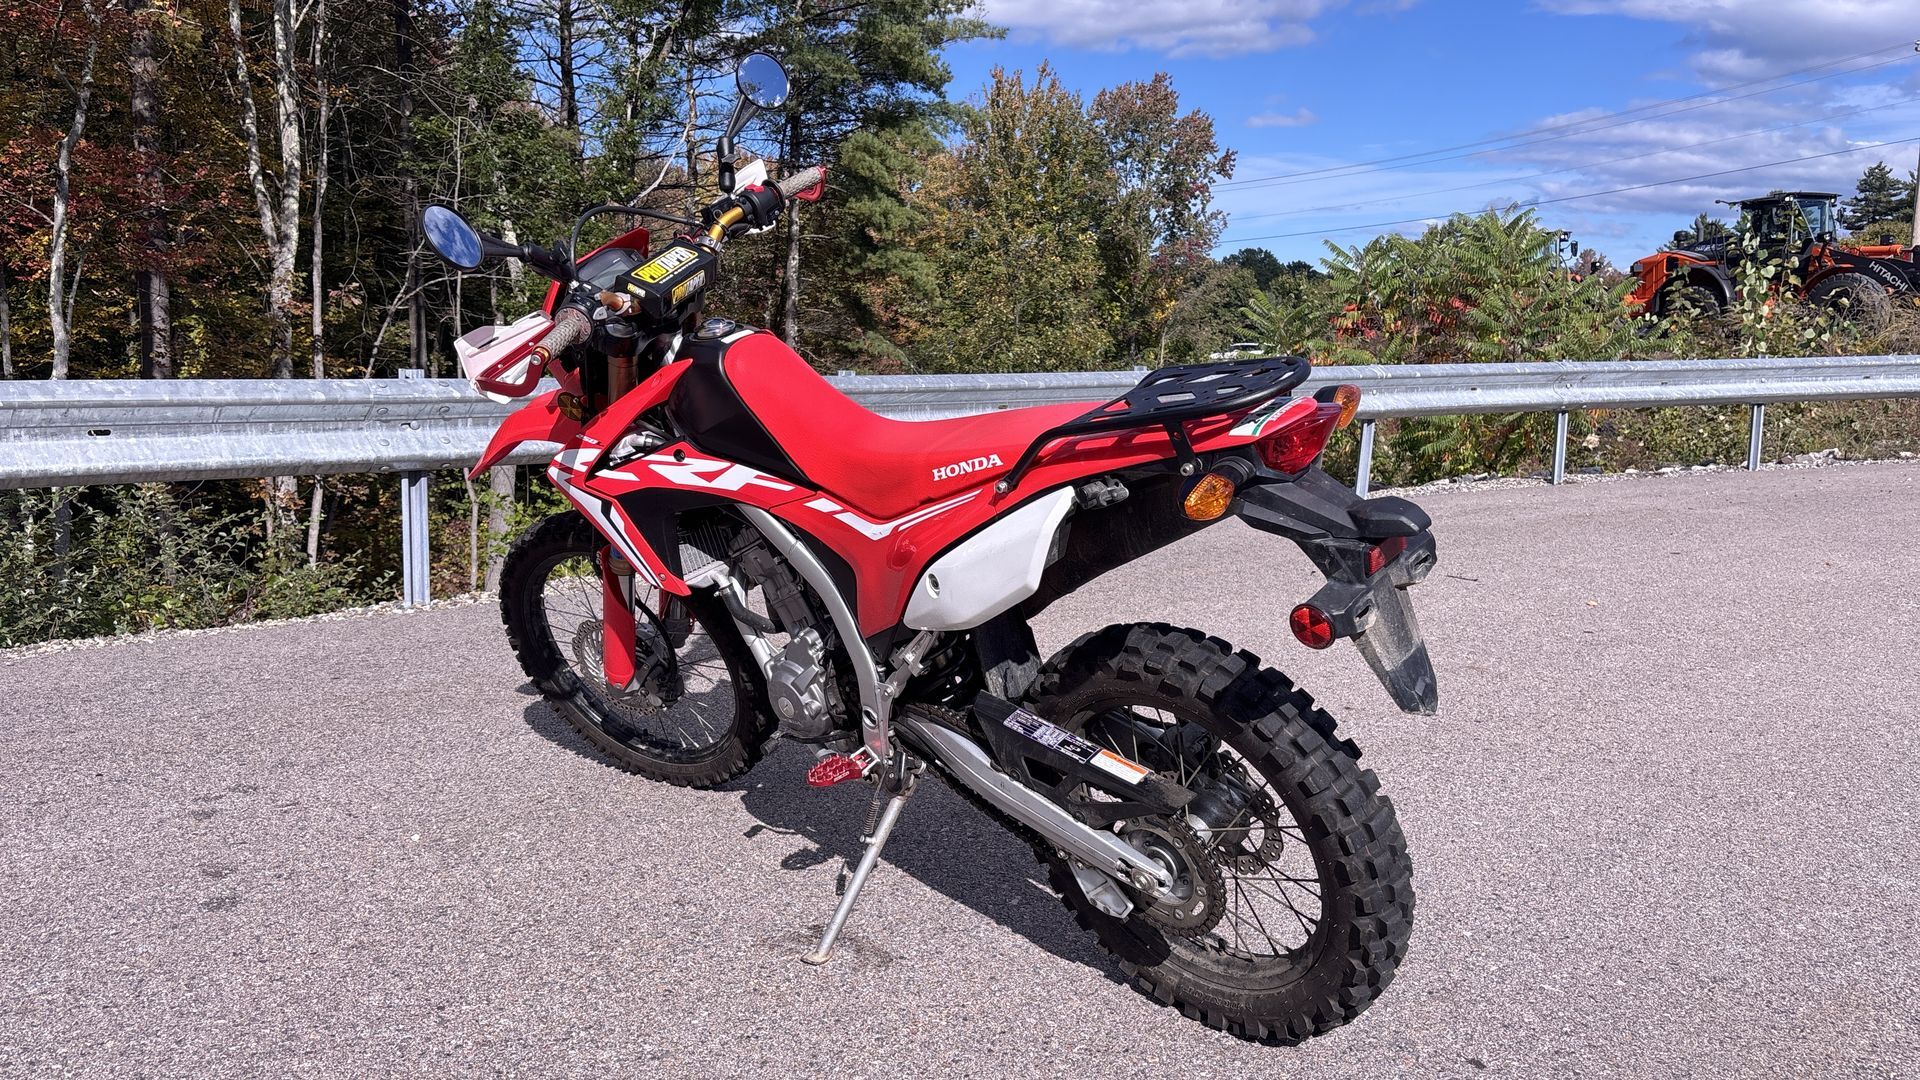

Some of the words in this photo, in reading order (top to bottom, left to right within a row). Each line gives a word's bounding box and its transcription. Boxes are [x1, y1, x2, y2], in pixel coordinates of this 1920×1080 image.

[636, 247, 697, 281] PROTAPER
[1868, 260, 1909, 292] HITACHI
[931, 453, 1004, 482] HONDA
